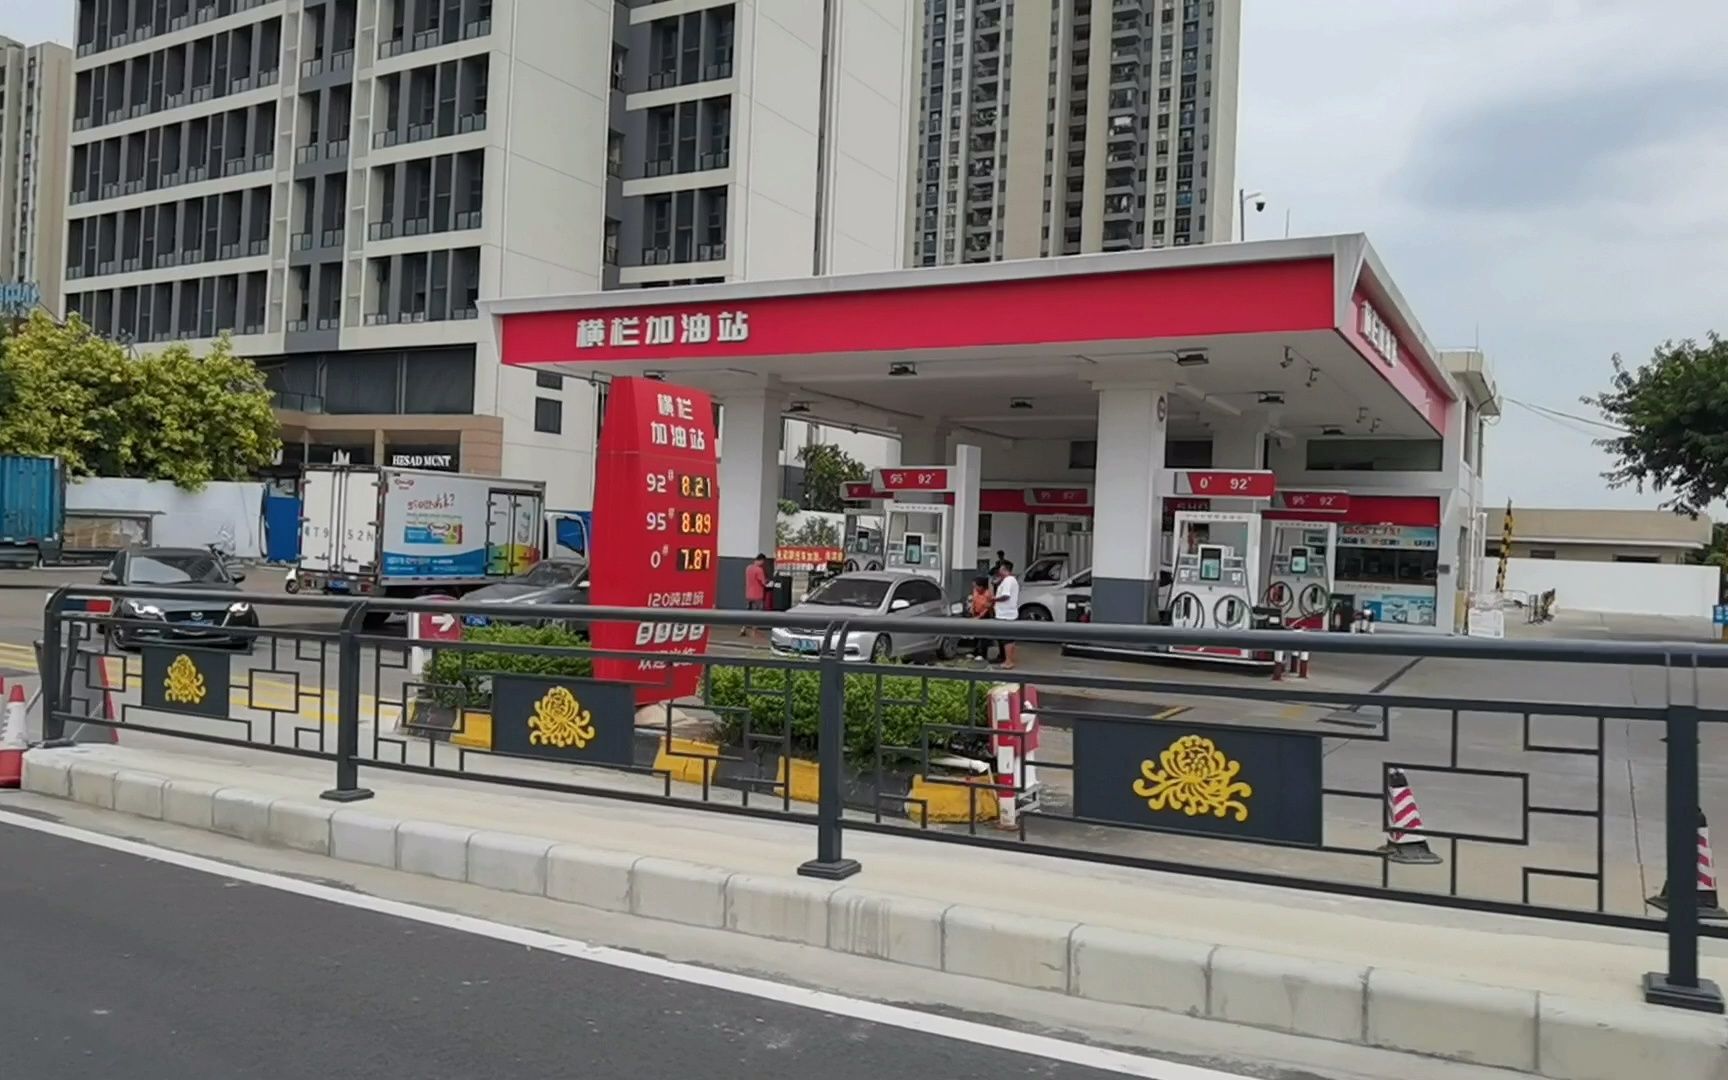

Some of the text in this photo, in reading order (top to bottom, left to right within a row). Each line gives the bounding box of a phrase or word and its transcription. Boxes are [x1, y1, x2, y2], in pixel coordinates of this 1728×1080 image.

[576, 311, 748, 348] 横栏加油站
[657, 393, 694, 420] 横栏
[650, 421, 705, 450] 加油站
[682, 475, 711, 497] 8.21
[682, 512, 711, 534] 8.89
[681, 548, 711, 570] 7.87
